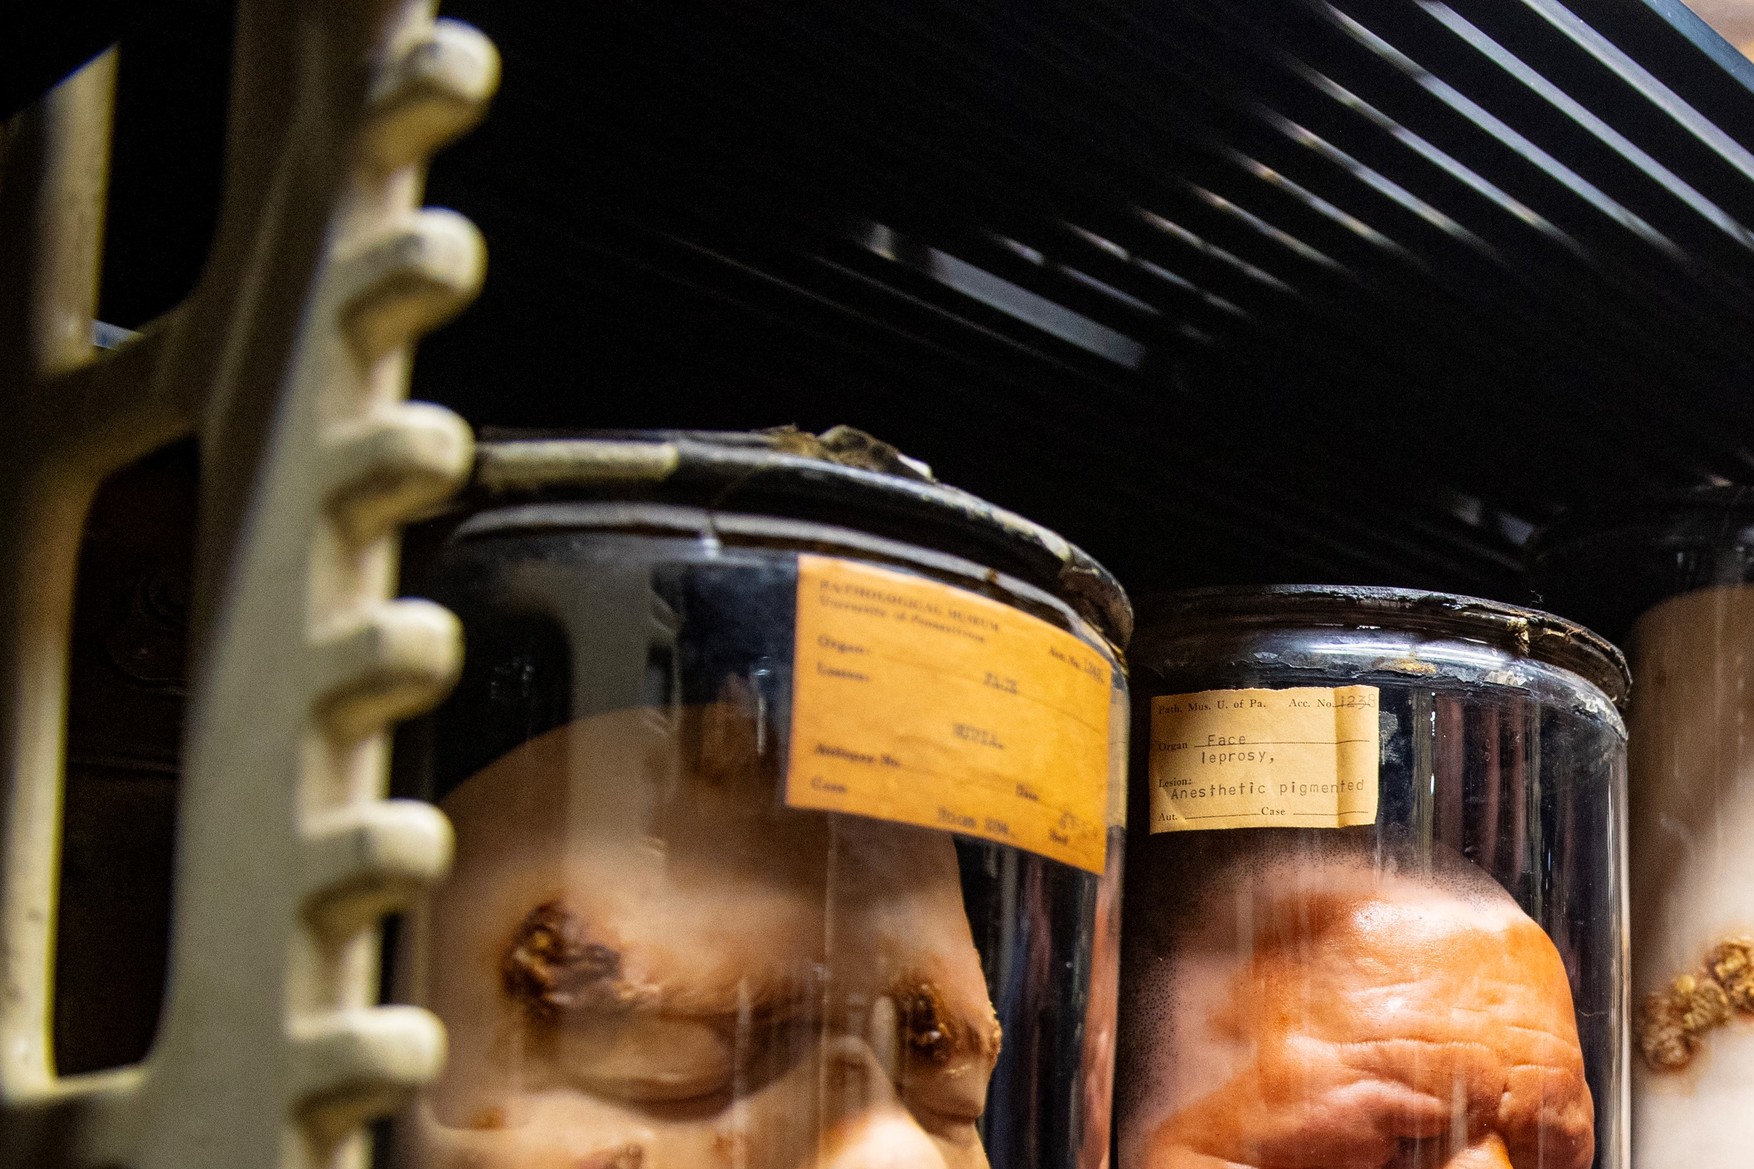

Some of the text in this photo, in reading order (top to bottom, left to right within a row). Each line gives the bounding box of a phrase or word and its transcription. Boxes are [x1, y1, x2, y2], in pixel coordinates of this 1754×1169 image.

[1158, 693, 1377, 715] Path. Mus. U. of Pa. Acc. No. 1238
[1158, 734, 1247, 752] Organ Face
[1201, 750, 1275, 765] leprosy,
[1158, 777, 1192, 789] Lesion:
[1170, 779, 1365, 801] Anesthetic pigmented
[1158, 807, 1286, 823] Aut. Case
